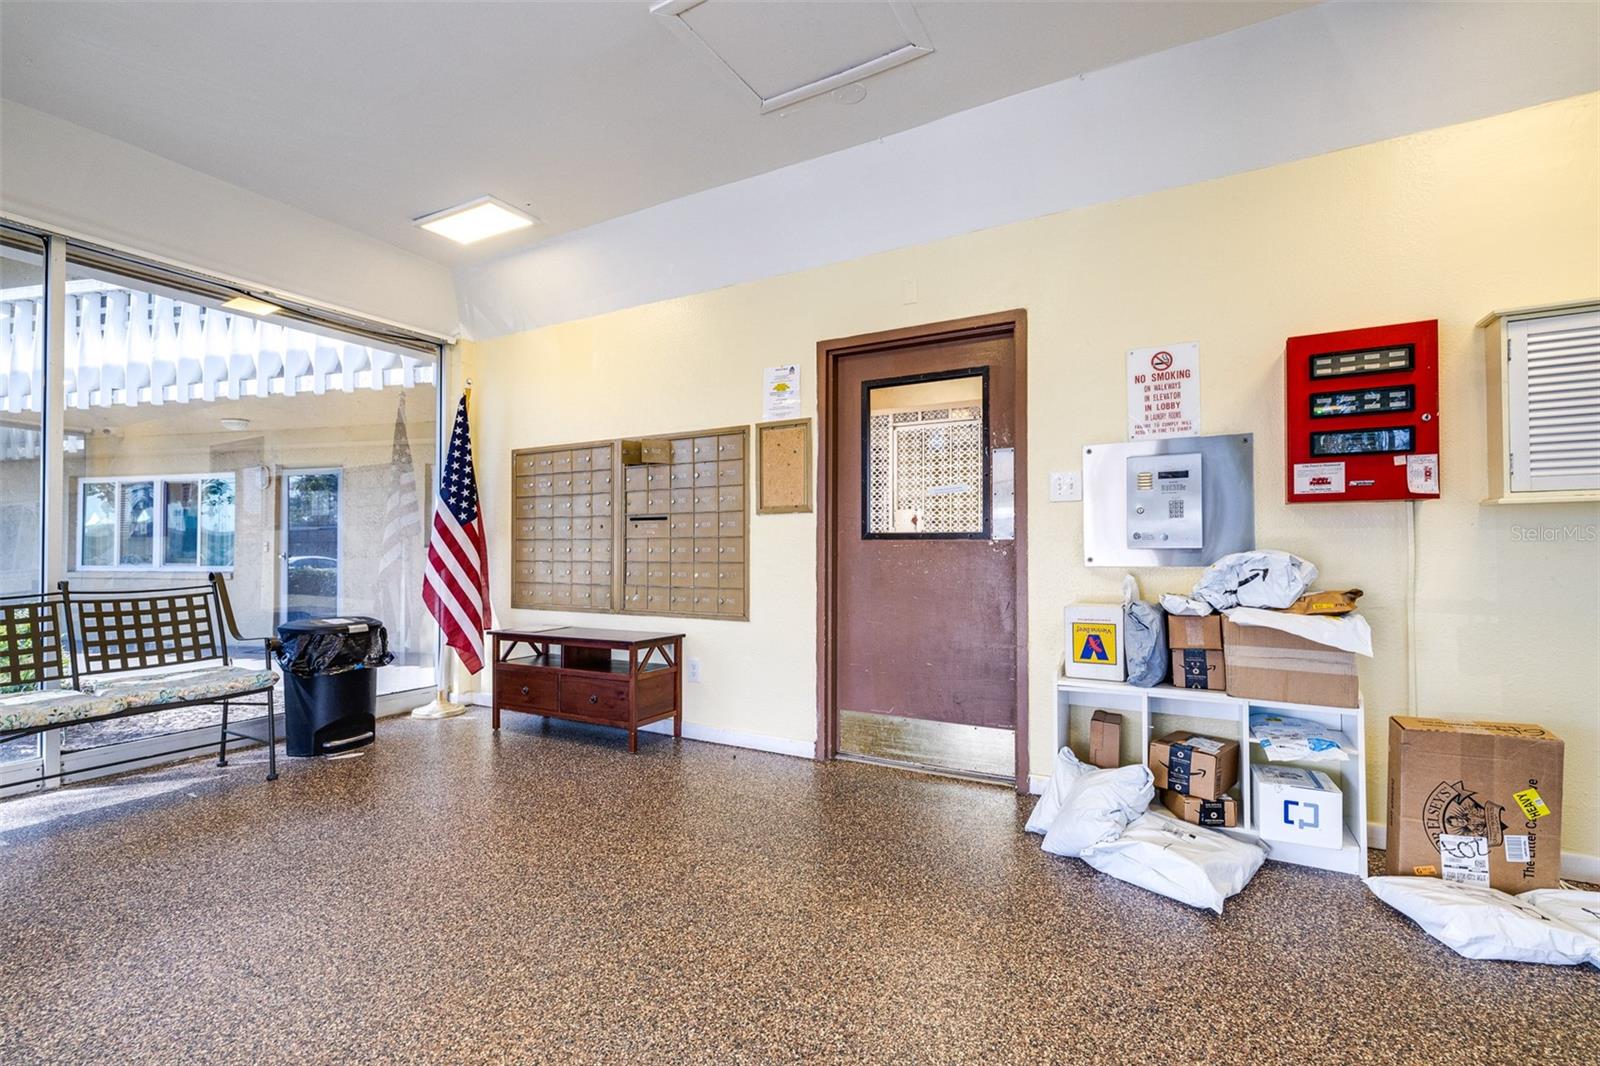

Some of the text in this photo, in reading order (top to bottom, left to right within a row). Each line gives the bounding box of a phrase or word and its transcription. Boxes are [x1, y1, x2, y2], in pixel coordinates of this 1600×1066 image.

[1134, 369, 1191, 384] NO SMOKING
[1154, 382, 1181, 391] WALKWAYS
[1153, 391, 1181, 401] ELEVATOR
[1144, 401, 1181, 412] IN LOBBY
[1517, 793, 1541, 818] HEAVY
[1523, 861, 1535, 879] The
